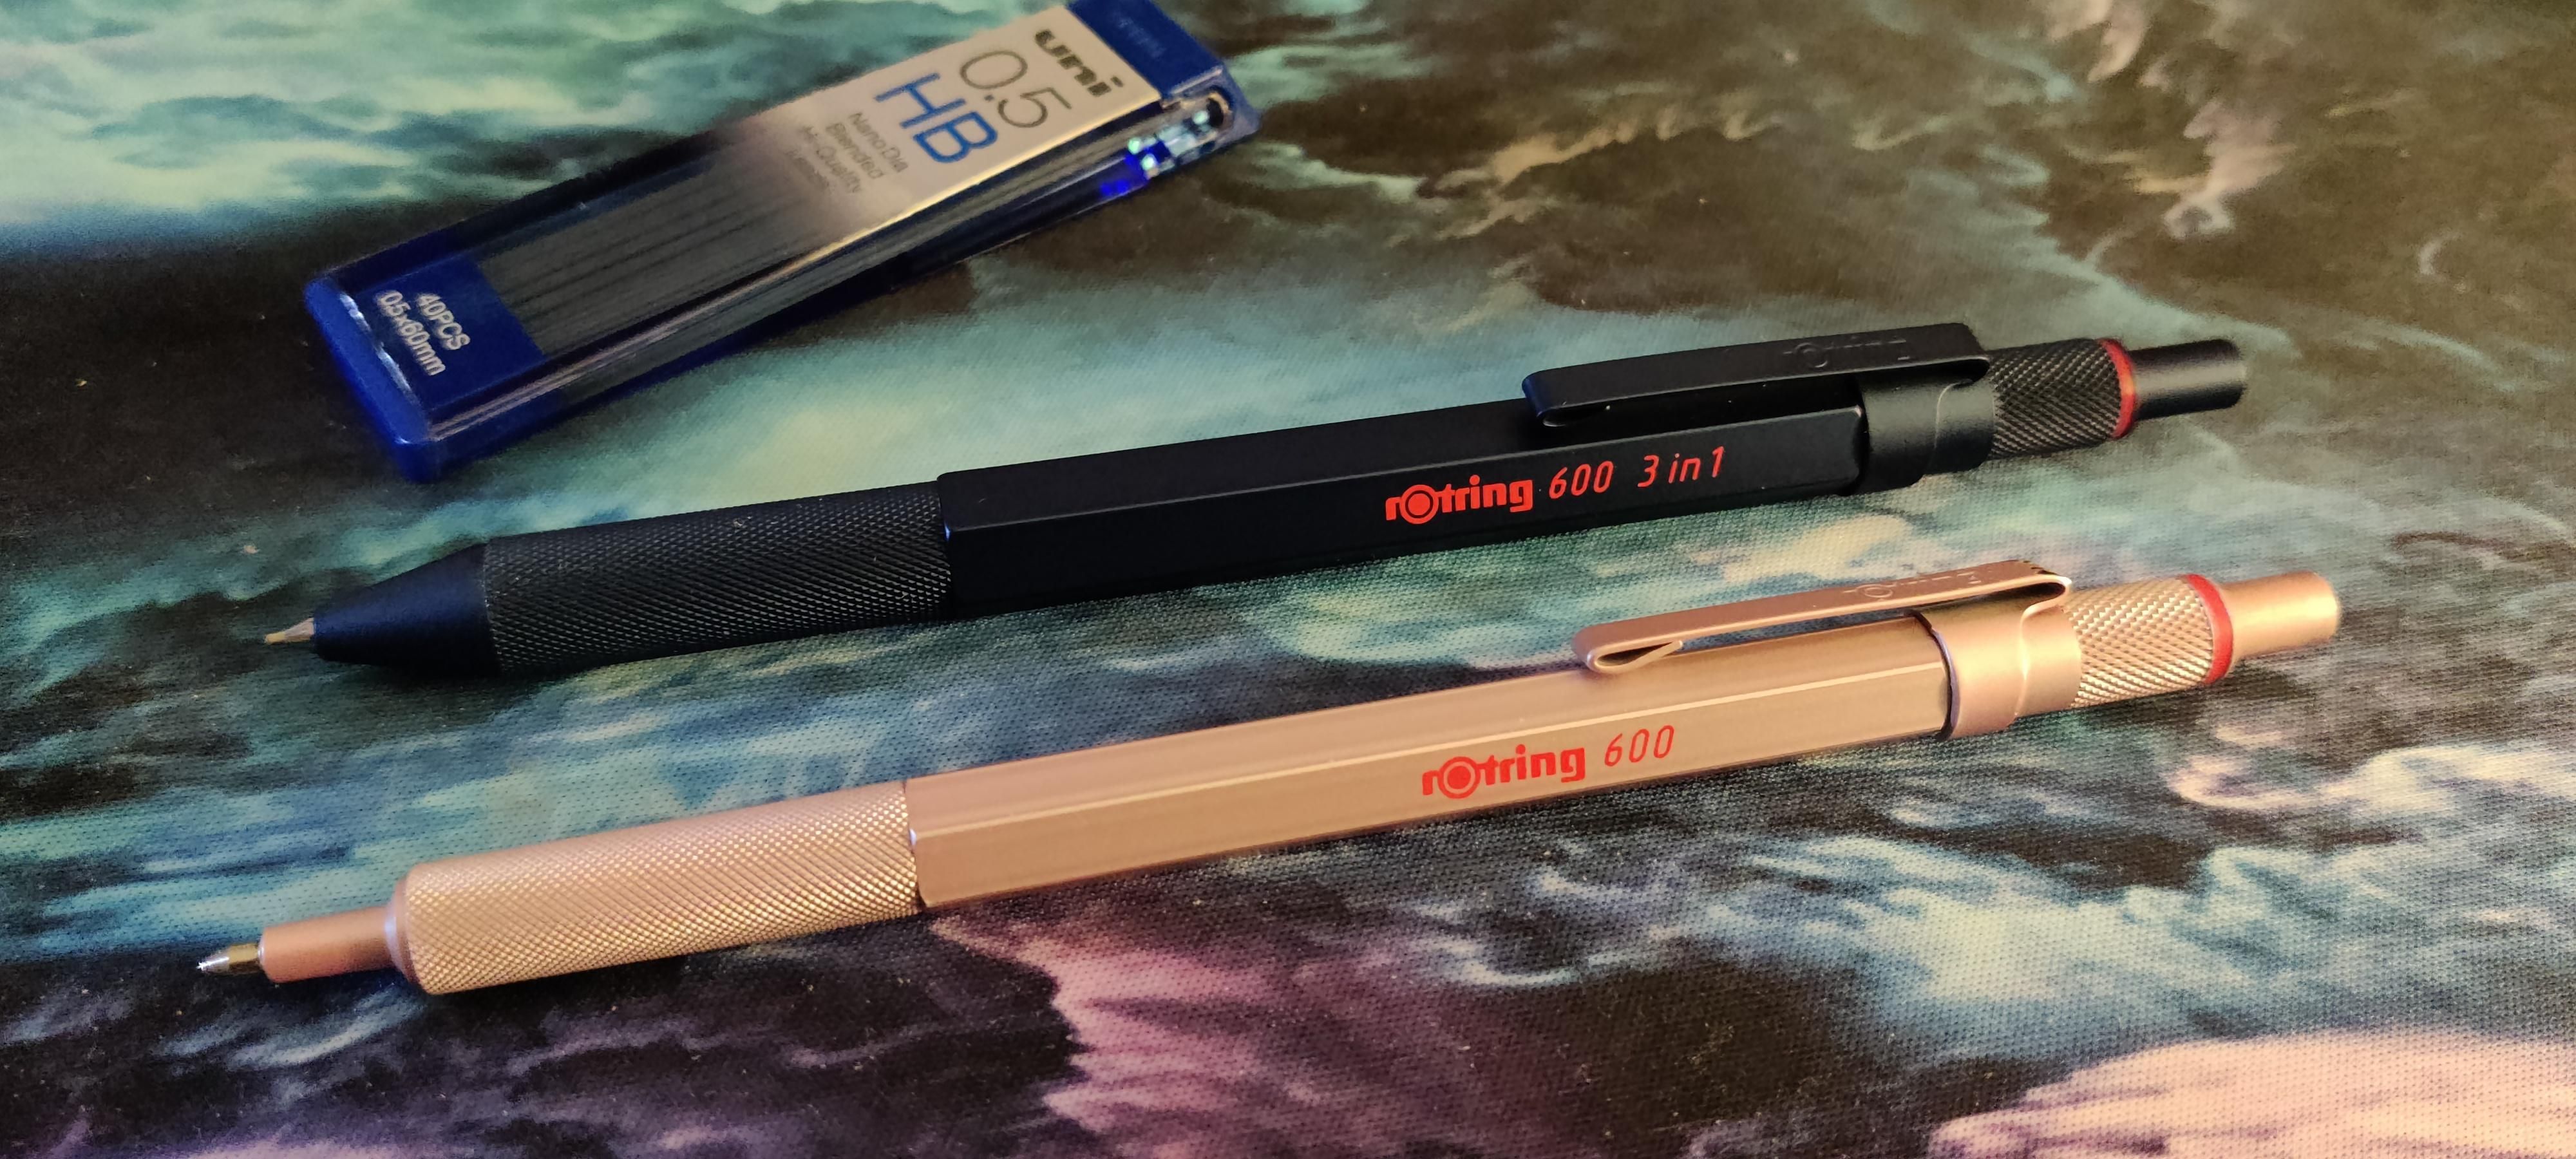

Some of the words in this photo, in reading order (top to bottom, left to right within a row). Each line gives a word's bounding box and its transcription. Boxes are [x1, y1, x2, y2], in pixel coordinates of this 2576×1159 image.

[959, 50, 1073, 129] 0.5
[1034, 29, 1124, 98] uni
[874, 71, 998, 164] HB
[414, 291, 471, 351] 40PCS
[1385, 475, 1533, 525] rotring
[1549, 460, 1614, 500] 600
[1638, 455, 1658, 487] 3
[1668, 453, 1700, 484] in
[1711, 446, 1725, 478] 1
[1422, 744, 1586, 799] rotring
[1604, 725, 1675, 768] 600
